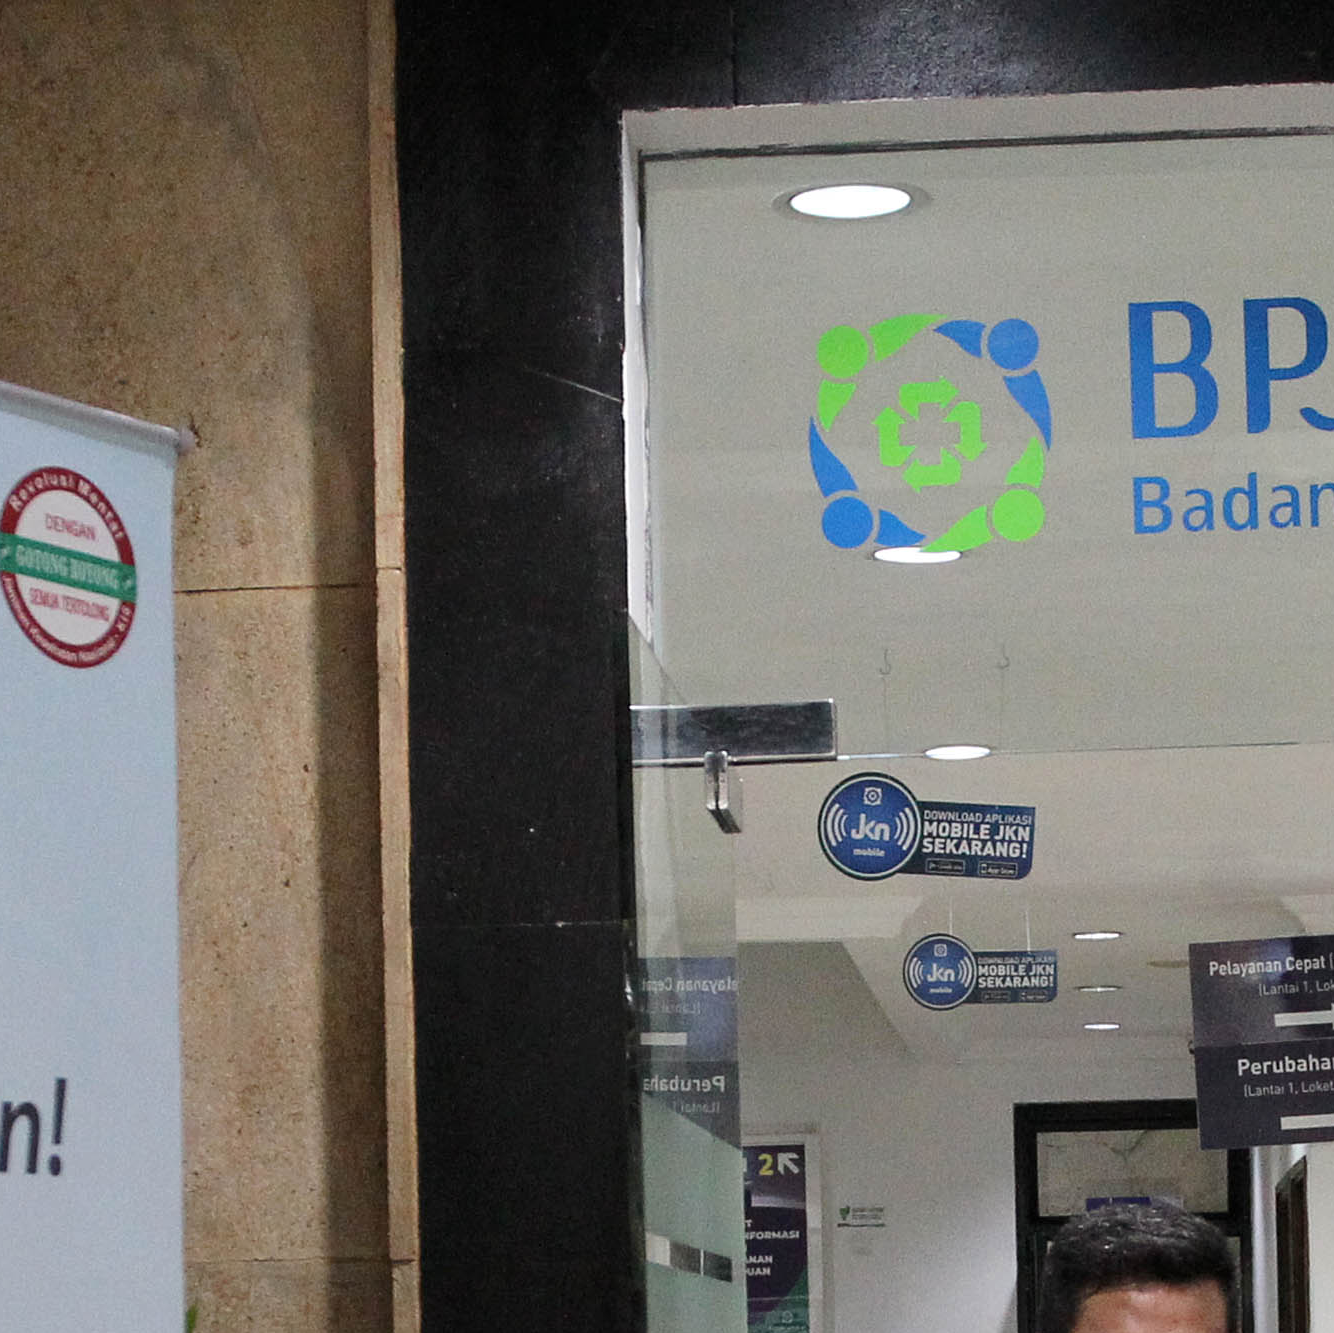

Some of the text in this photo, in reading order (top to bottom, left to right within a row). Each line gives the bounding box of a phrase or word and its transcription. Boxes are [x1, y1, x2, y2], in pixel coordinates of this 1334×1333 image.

[8, 471, 125, 540] Revolusi Mental
[45, 512, 97, 542] DENGAN
[923, 809, 1033, 826] DOWNLOAD APLIKASI
[923, 821, 1031, 842] MOBILE JKN
[852, 847, 886, 857] mobile
[921, 837, 1028, 859] SEKARANG!
[977, 963, 1055, 977] MOBILE JKN
[1208, 958, 1283, 978] Pelayanan
[1285, 954, 1327, 975] Cepat
[978, 975, 1055, 988] SEKARANG!
[1301, 1078, 1334, 1094] Loket
[758, 1153, 775, 1176] 2
[745, 1230, 800, 1241] NFORMASI
